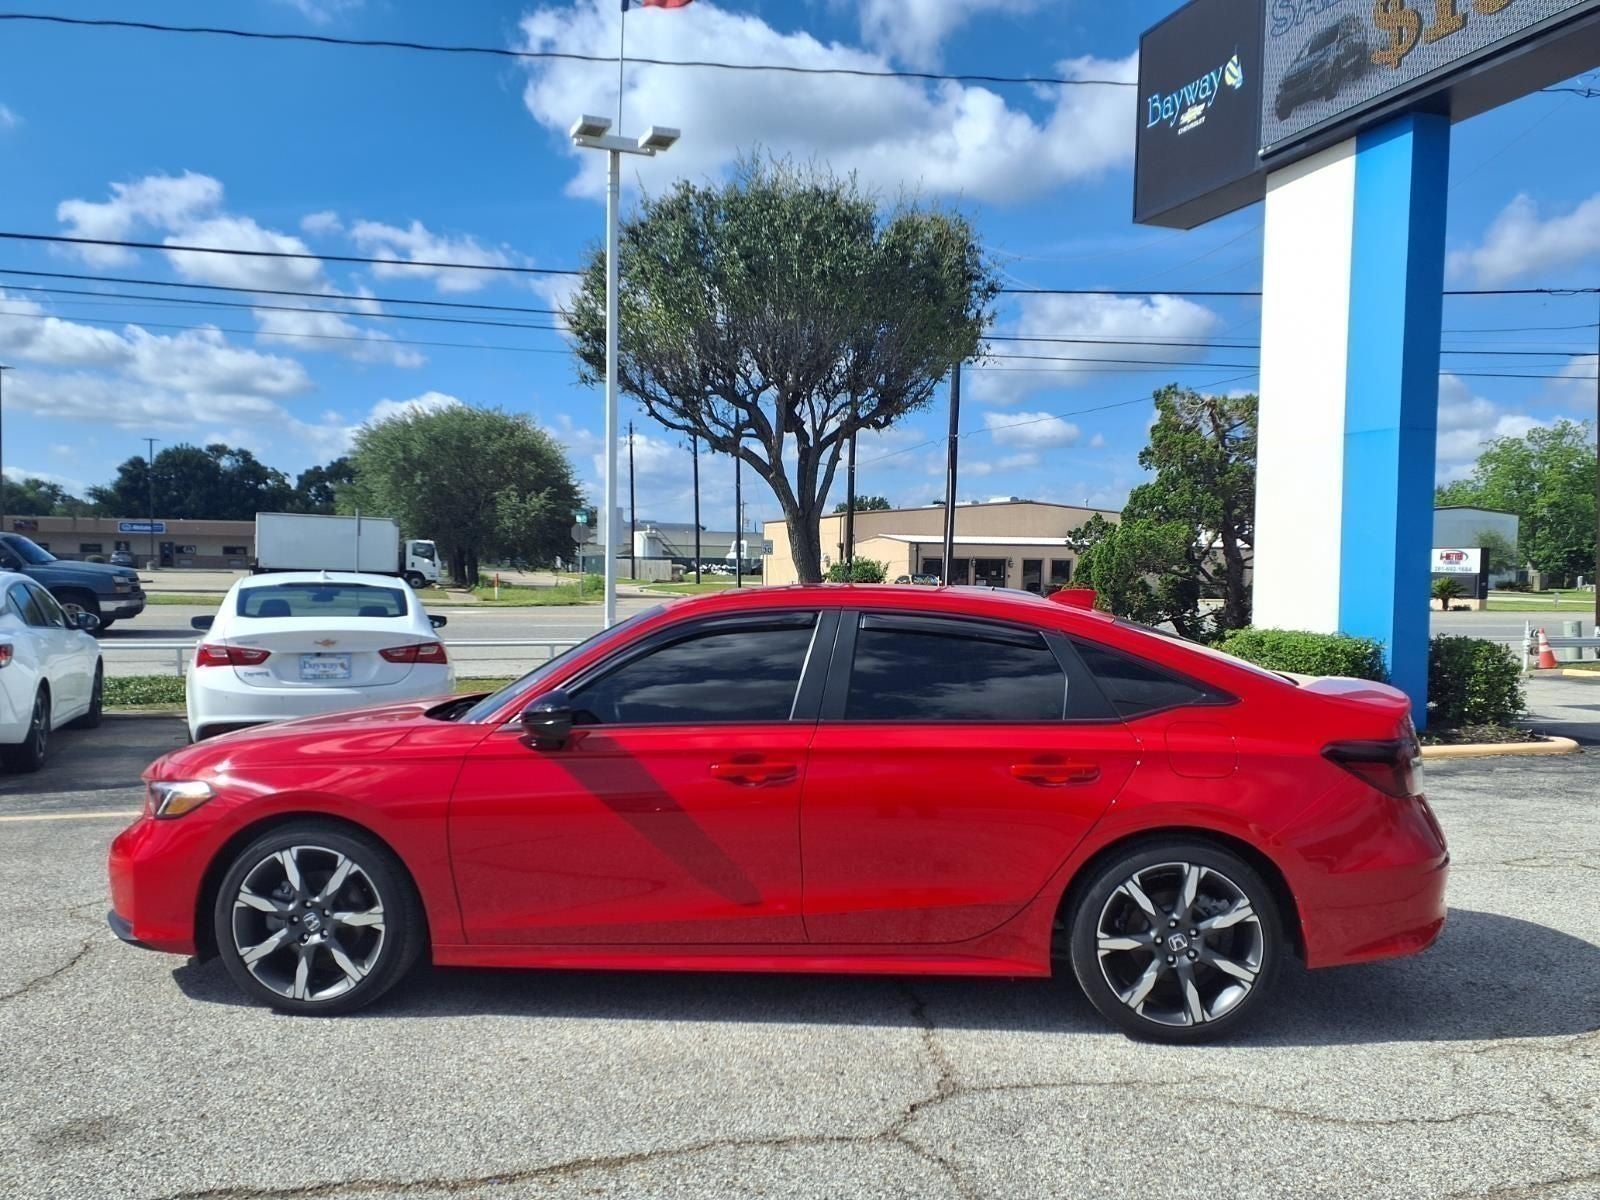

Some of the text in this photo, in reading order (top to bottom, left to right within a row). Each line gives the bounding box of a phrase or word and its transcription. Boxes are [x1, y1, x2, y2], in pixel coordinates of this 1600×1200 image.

[1270, 0, 1343, 37] SA
[1146, 64, 1224, 129] Bayway
[1177, 115, 1206, 136] CHEVROLET
